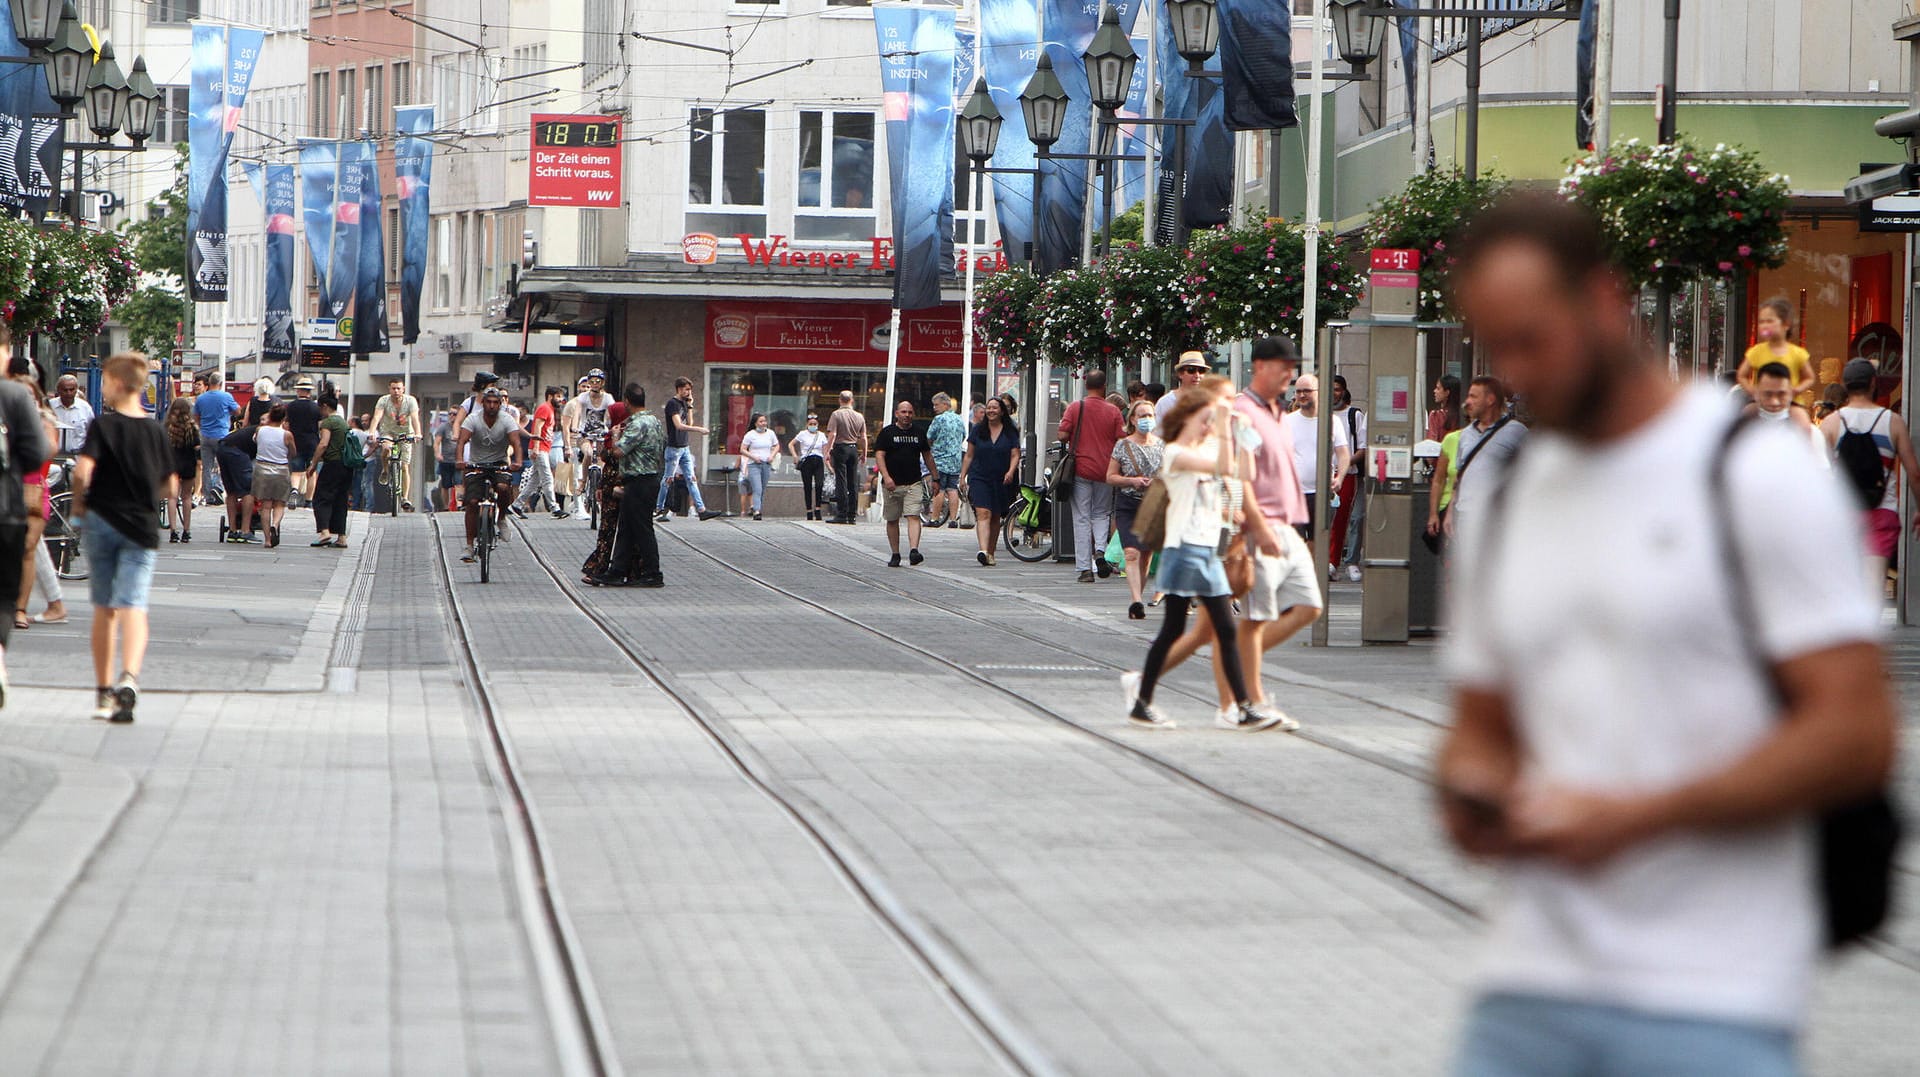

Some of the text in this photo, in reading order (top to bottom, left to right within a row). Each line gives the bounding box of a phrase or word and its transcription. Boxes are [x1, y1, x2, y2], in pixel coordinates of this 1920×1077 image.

[545, 124, 570, 145] 18
[536, 152, 610, 165] Der Zeit einen
[535, 166, 614, 179] Schritt voraus.
[733, 233, 860, 269] Wiener
[313, 327, 330, 335] Dom
[791, 320, 833, 333] Wiener
[917, 323, 958, 336] Warme
[779, 332, 844, 346] Feinbäcker
